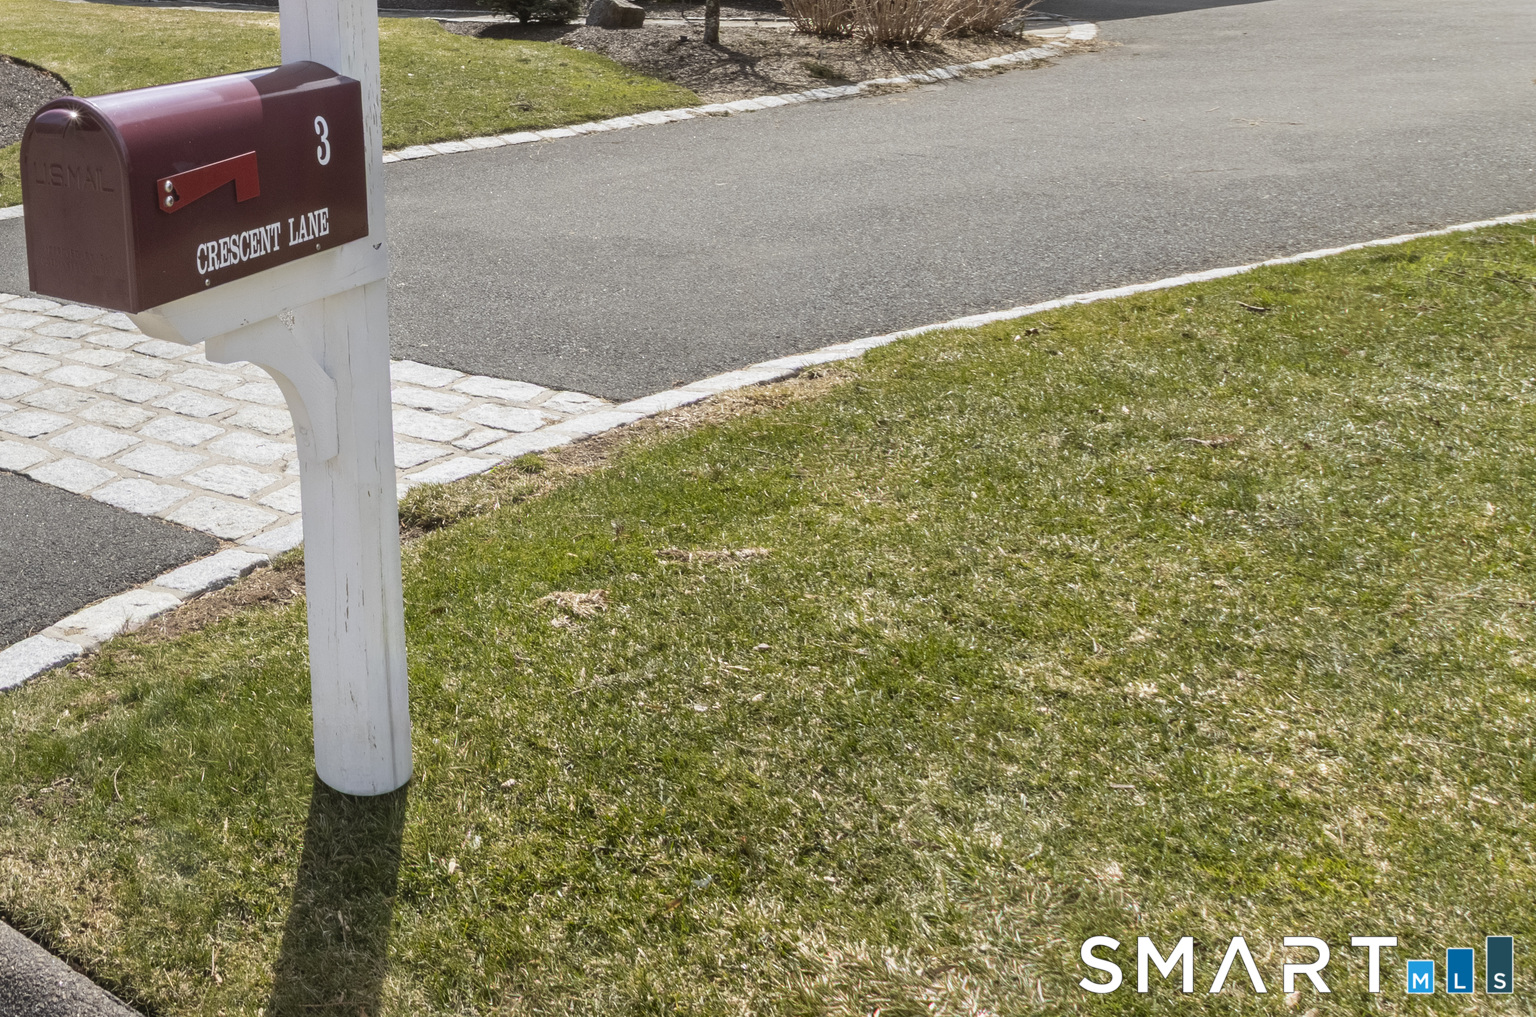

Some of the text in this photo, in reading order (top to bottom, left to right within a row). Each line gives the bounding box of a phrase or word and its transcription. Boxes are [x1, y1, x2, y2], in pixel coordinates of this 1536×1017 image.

[314, 115, 331, 166] 3
[196, 207, 330, 275] CRESCENT LANE
